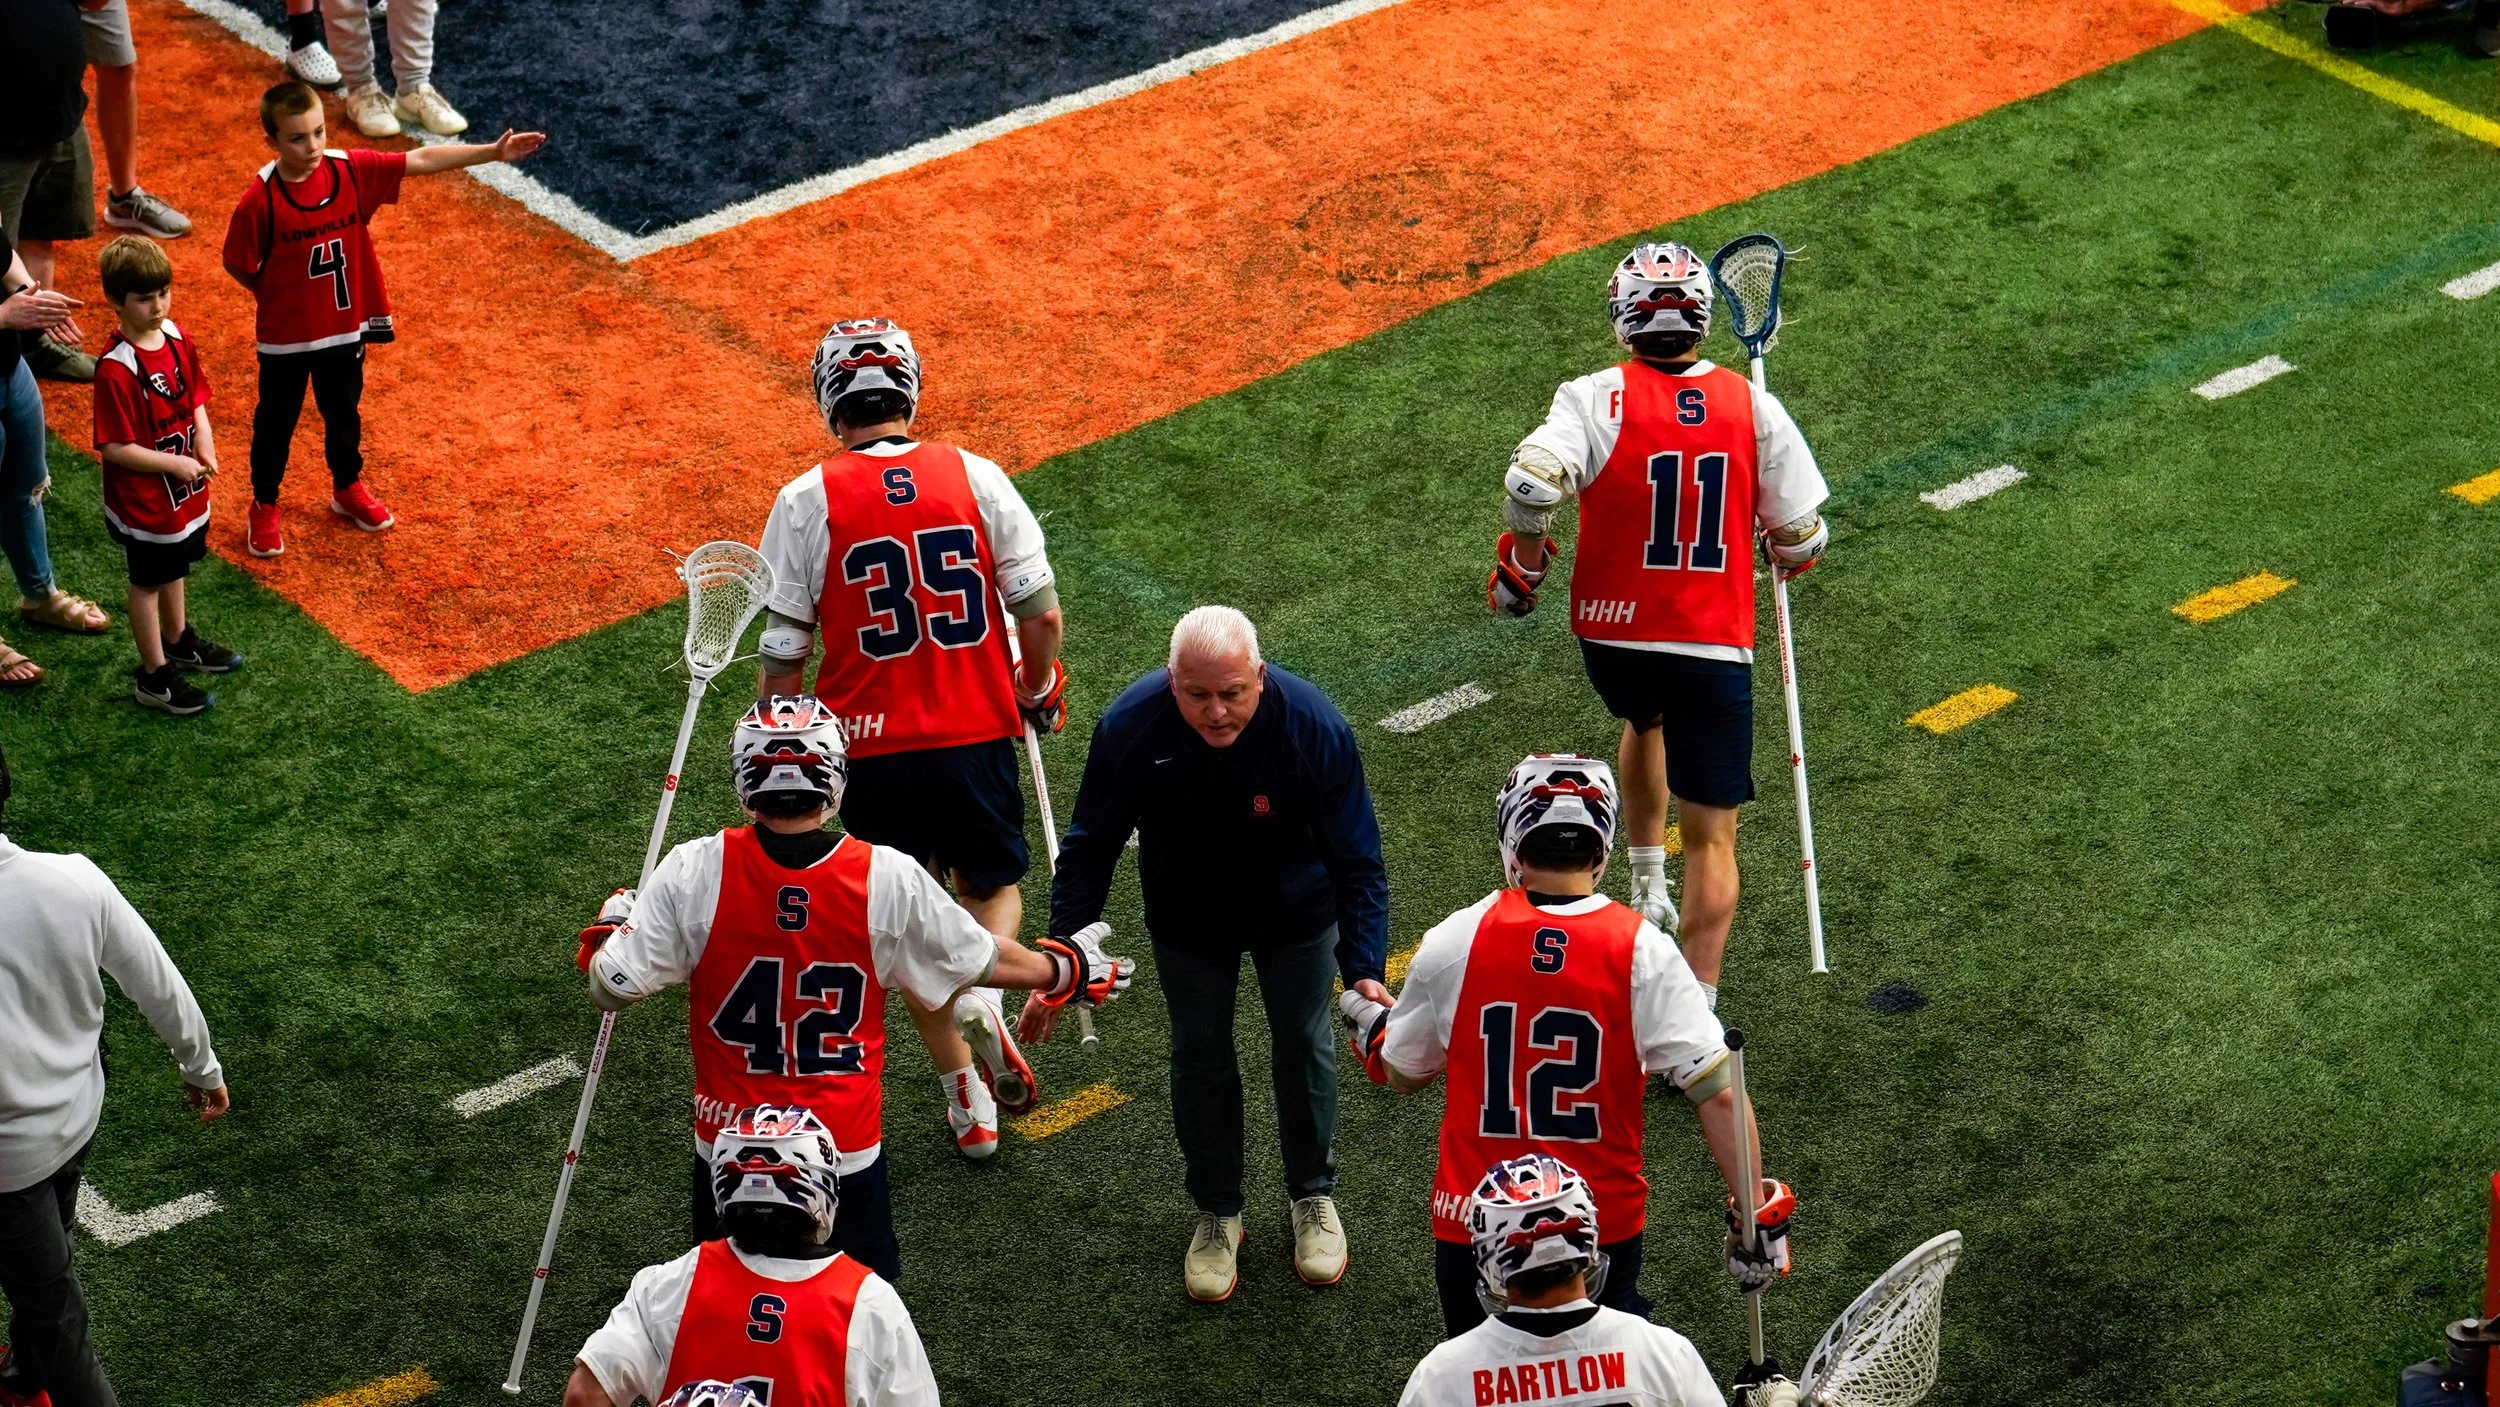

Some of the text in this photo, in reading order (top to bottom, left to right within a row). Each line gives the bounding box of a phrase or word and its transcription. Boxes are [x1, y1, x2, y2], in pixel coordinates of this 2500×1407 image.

[281, 212, 357, 242] LOWVILLE
[308, 238, 351, 311] 4
[1676, 388, 1706, 426] S
[881, 466, 917, 507] S
[1642, 450, 1729, 573] 11
[841, 524, 990, 661] 35
[1578, 599, 1637, 624] HHH
[838, 712, 885, 740] HH
[665, 774, 678, 791] S
[1253, 795, 1270, 812] S
[776, 885, 809, 932] S
[1530, 926, 1569, 975] S
[708, 956, 868, 1077] 42
[1479, 1001, 1603, 1143] 12
[746, 1292, 787, 1344] S
[1473, 1352, 1625, 1407] BARTLOW
